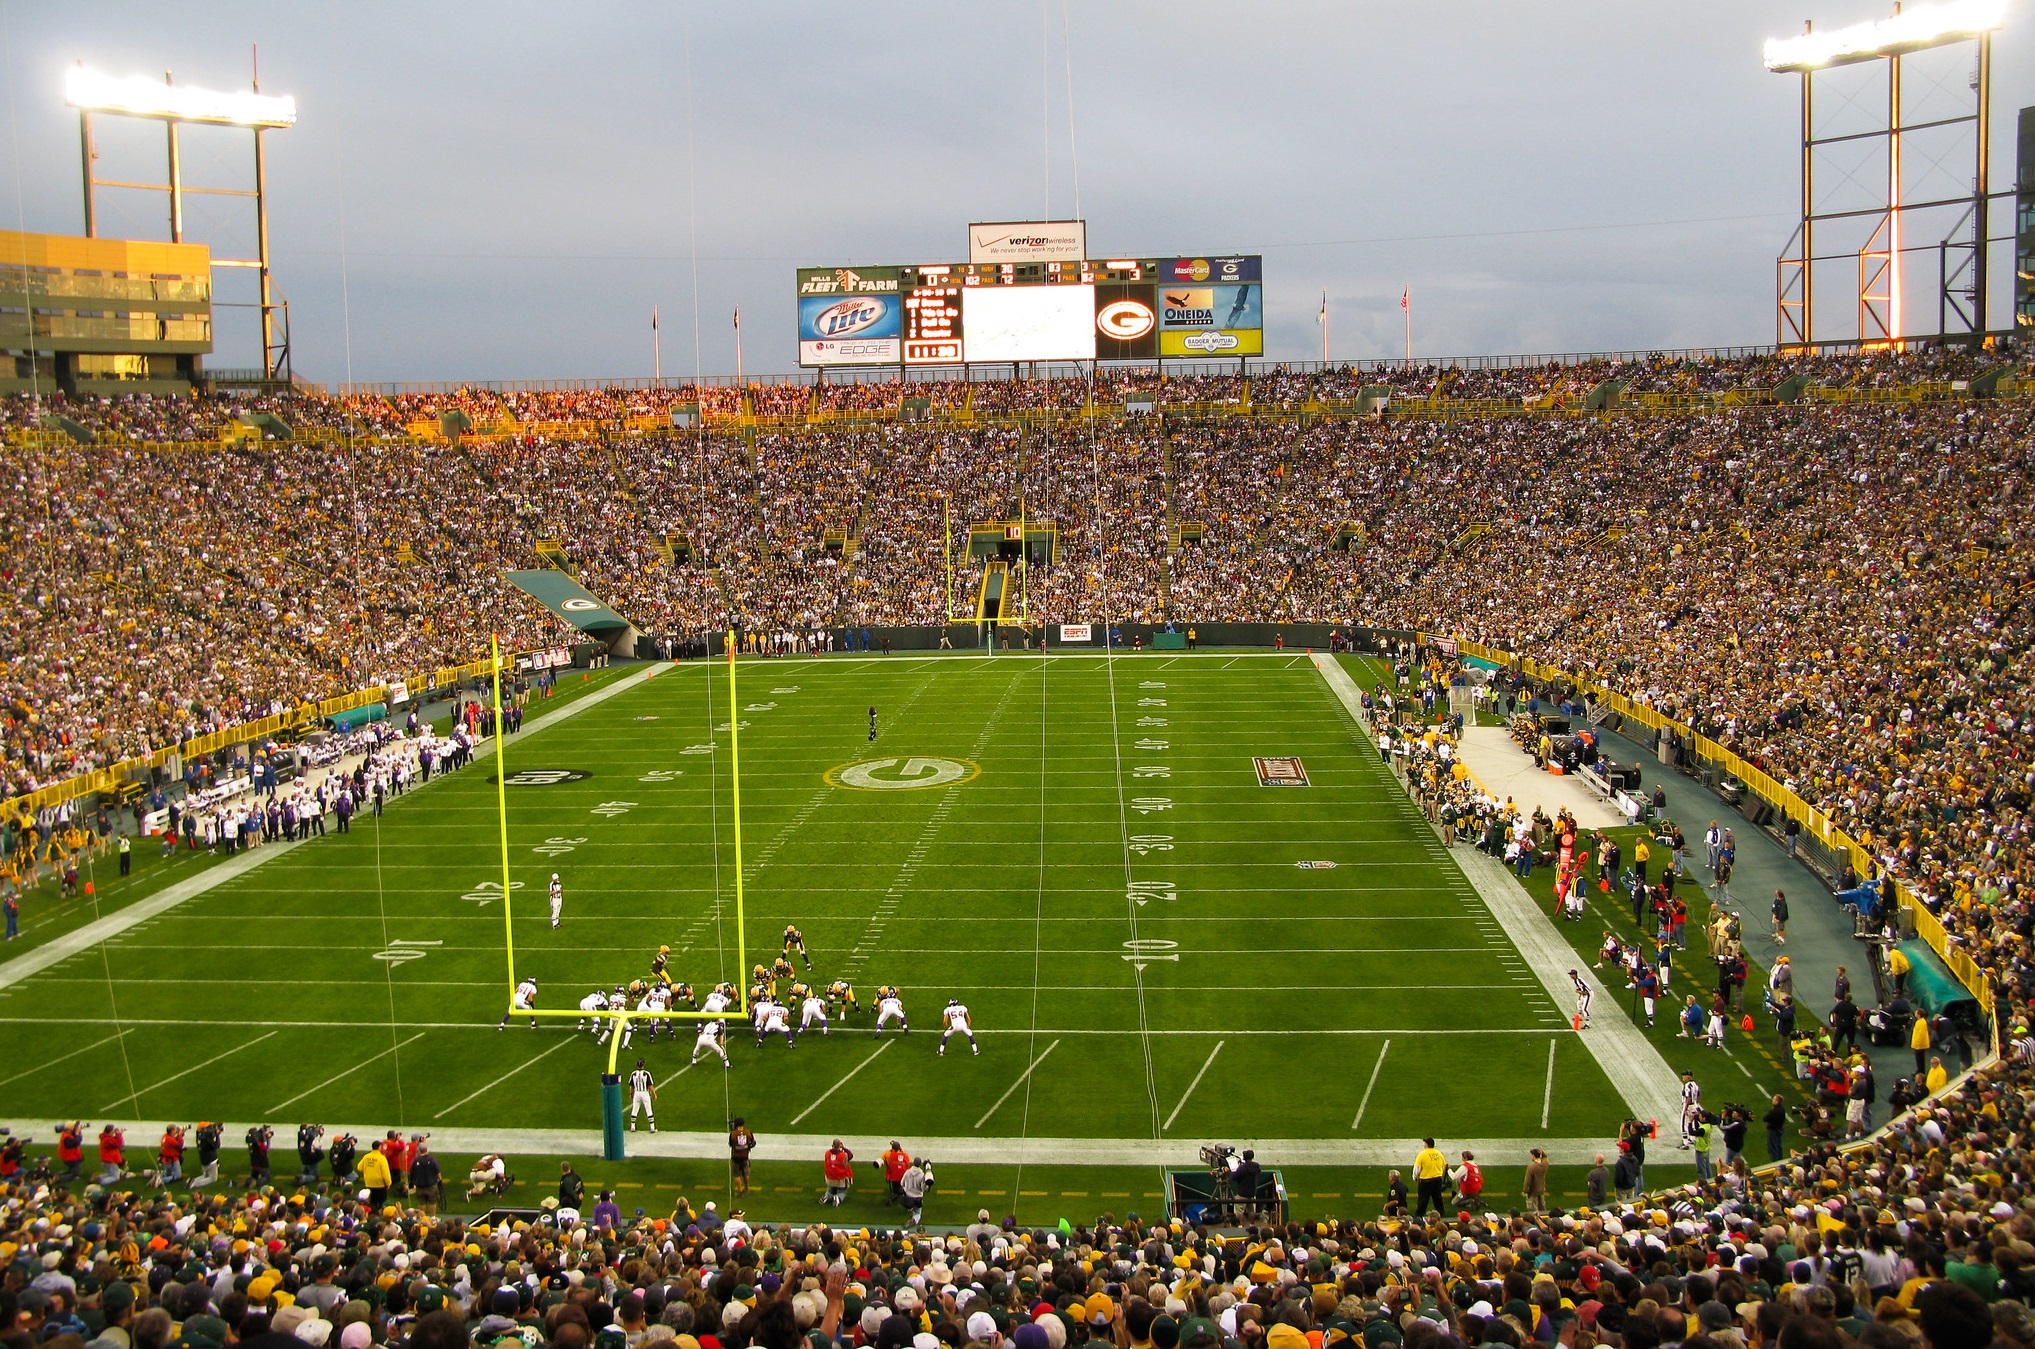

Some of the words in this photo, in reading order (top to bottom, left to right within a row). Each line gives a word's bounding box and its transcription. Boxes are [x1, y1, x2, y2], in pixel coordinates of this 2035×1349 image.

[1009, 236, 1048, 247] verizon
[1018, 246, 1031, 254] stop
[968, 265, 975, 274] 3
[1001, 264, 1013, 273] 30
[1049, 263, 1060, 272] 83
[1082, 262, 1088, 271] 3
[1223, 264, 1238, 273] G
[1130, 269, 1140, 280] 3
[965, 276, 980, 285] 102
[801, 282, 840, 293] FLEET
[858, 280, 898, 292] FARM
[836, 302, 864, 313] Miller
[1165, 308, 1212, 319] ONEIDA
[826, 308, 875, 336] Lite
[840, 345, 891, 354] EDGE
[1010, 526, 1021, 538] 10
[1133, 766, 1171, 778] 50
[1131, 797, 1172, 810] 40
[532, 837, 588, 853] 30
[1128, 834, 1174, 850] 30
[460, 881, 525, 900] 20
[1126, 881, 1176, 900] 20
[372, 939, 443, 960] 10
[1121, 939, 1179, 961] 10
[651, 993, 665, 1002] 56
[950, 1011, 964, 1019] 54
